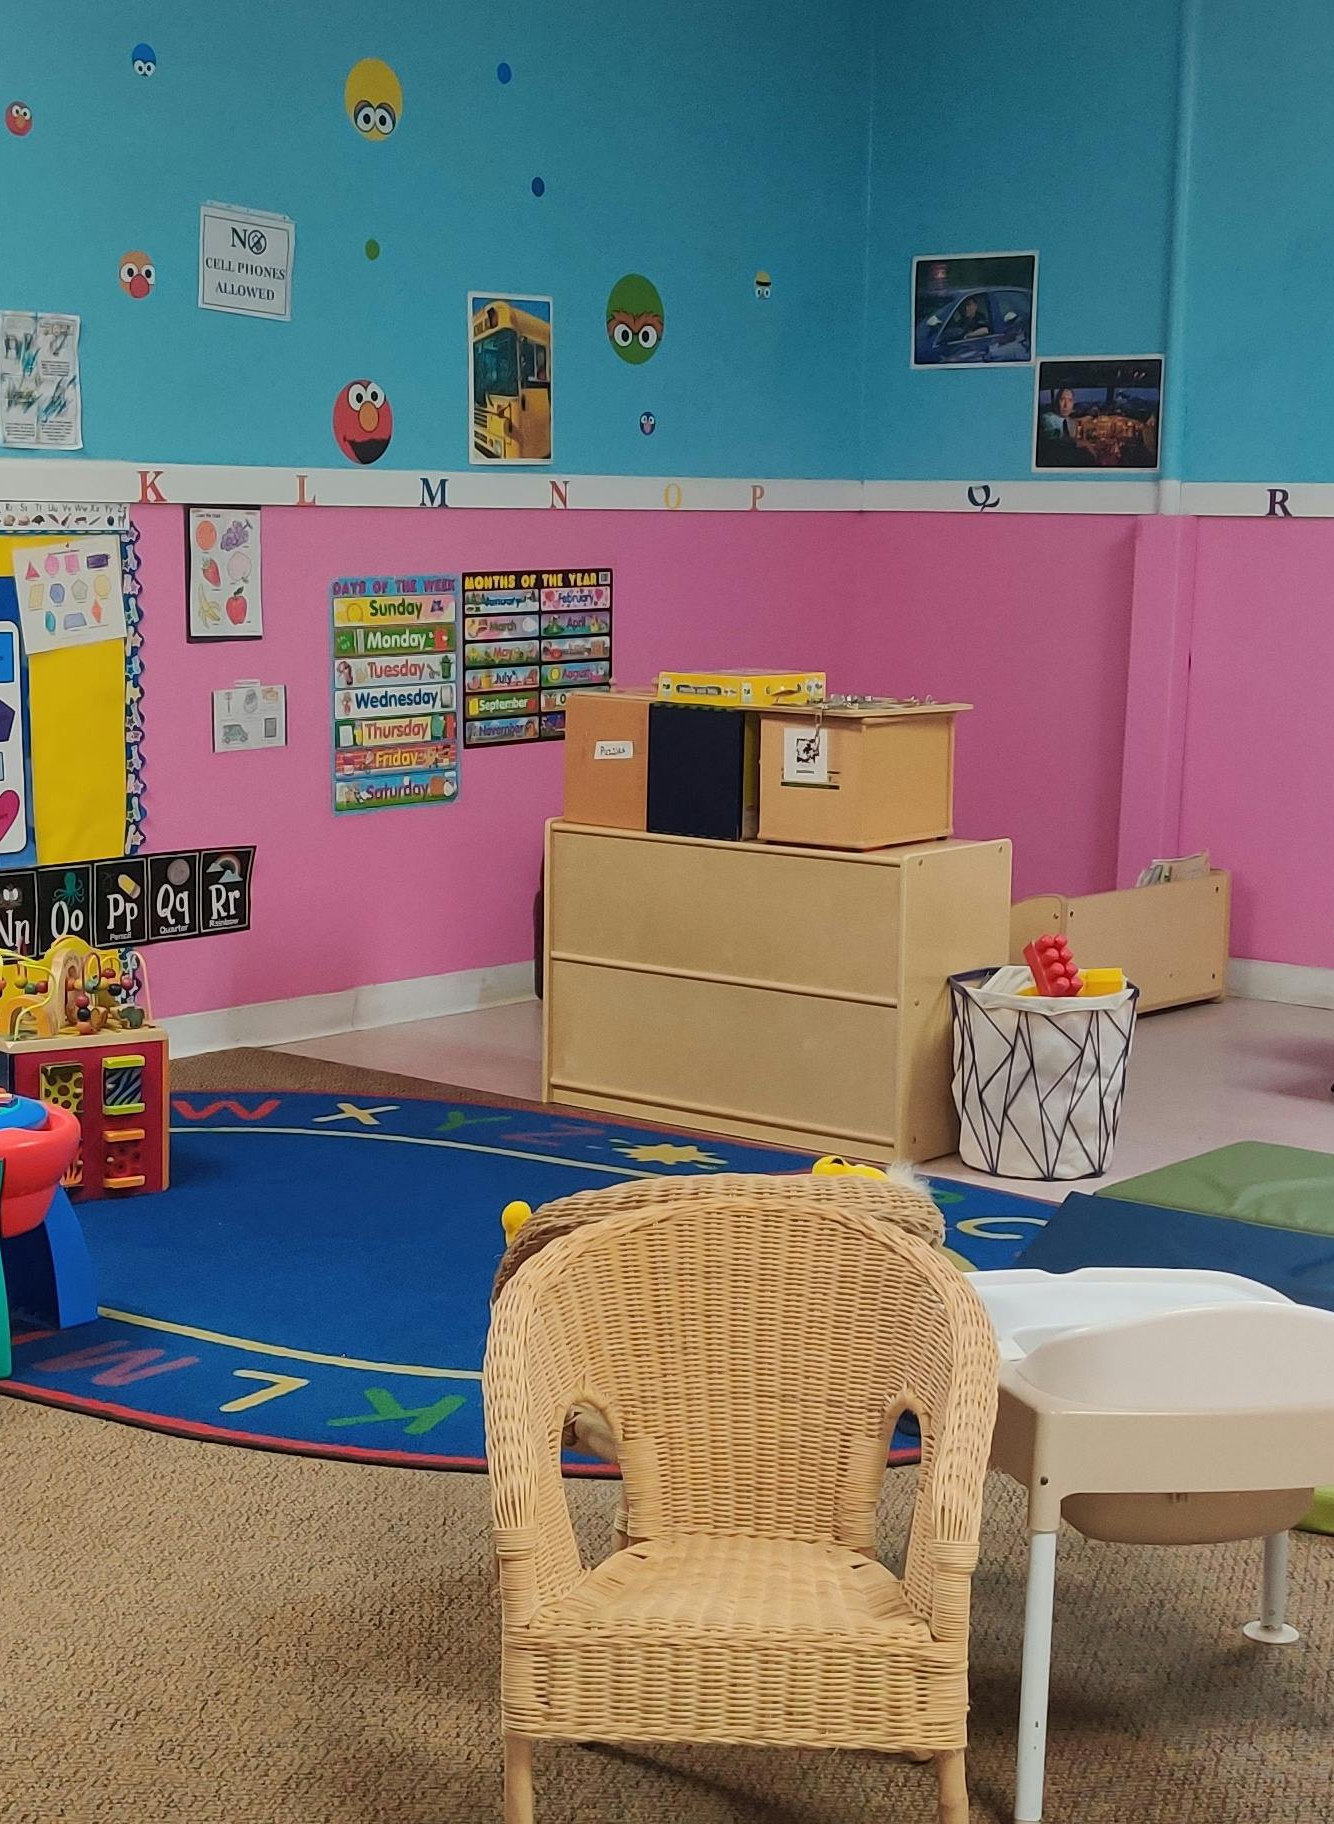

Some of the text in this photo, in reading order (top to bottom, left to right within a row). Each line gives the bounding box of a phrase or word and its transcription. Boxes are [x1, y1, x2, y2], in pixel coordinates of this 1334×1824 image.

[205, 256, 286, 281] CELL PHONES
[216, 281, 275, 302] ALLOWED
[137, 470, 168, 503] K
[296, 475, 316, 507] L
[419, 477, 449, 508] M
[548, 480, 570, 510] N
[663, 483, 682, 510] O
[749, 484, 765, 511] P
[967, 484, 1000, 512] Q
[1266, 488, 1293, 517] R
[333, 579, 455, 595] DAYS OF THE WEEK
[464, 572, 597, 590] MONTHS OF THE YEAR
[369, 598, 422, 620] Sunday
[558, 592, 594, 605] February
[566, 616, 586, 629] April
[367, 630, 426, 650] Monday
[367, 659, 425, 680] Tuesday
[494, 671, 512, 685] July
[355, 688, 438, 709] Wednesday
[478, 698, 528, 713] September
[365, 719, 428, 740] Thursday
[479, 722, 524, 736] November
[376, 747, 418, 768] Friday
[366, 782, 428, 800] Saturday
[156, 883, 190, 927] Qq
[209, 884, 240, 920] Rr
[51, 901, 84, 939] Oo
[107, 894, 139, 932] Pp
[209, 917, 239, 927] Rainbow
[110, 931, 132, 941] Pencil
[159, 923, 189, 934] Quarter
[172, 1100, 281, 1121] W
[312, 1102, 400, 1125] X
[434, 1111, 513, 1132] Y
[32, 1340, 200, 1388] M
[218, 1368, 311, 1413] L
[326, 1387, 467, 1436] K
